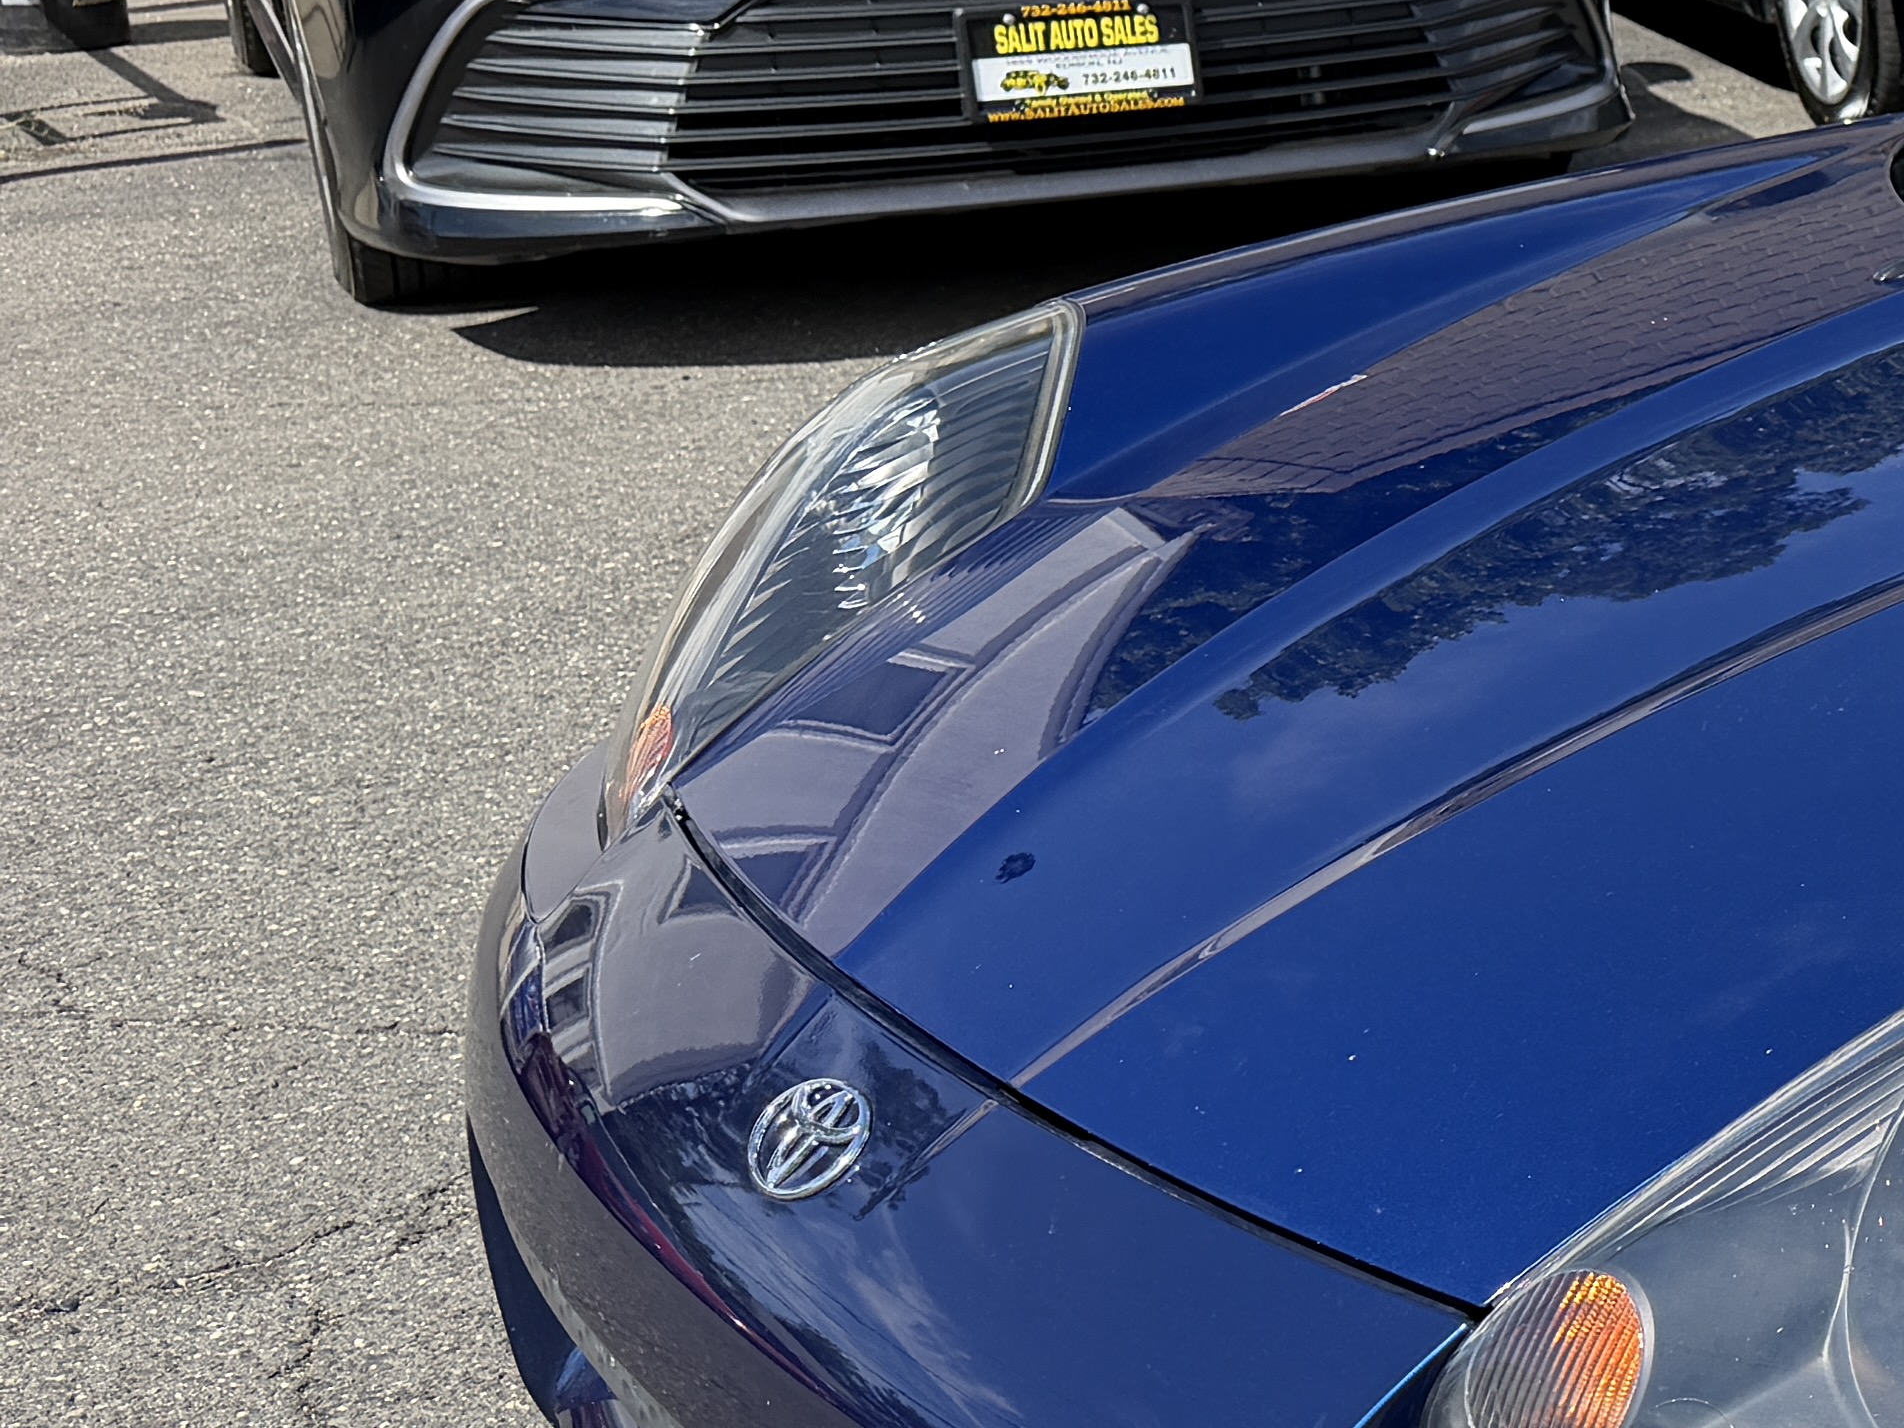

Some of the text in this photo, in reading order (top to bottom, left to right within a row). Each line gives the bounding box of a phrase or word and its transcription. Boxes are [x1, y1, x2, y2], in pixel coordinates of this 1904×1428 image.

[993, 14, 1160, 55] SALIT AUTO SALES
